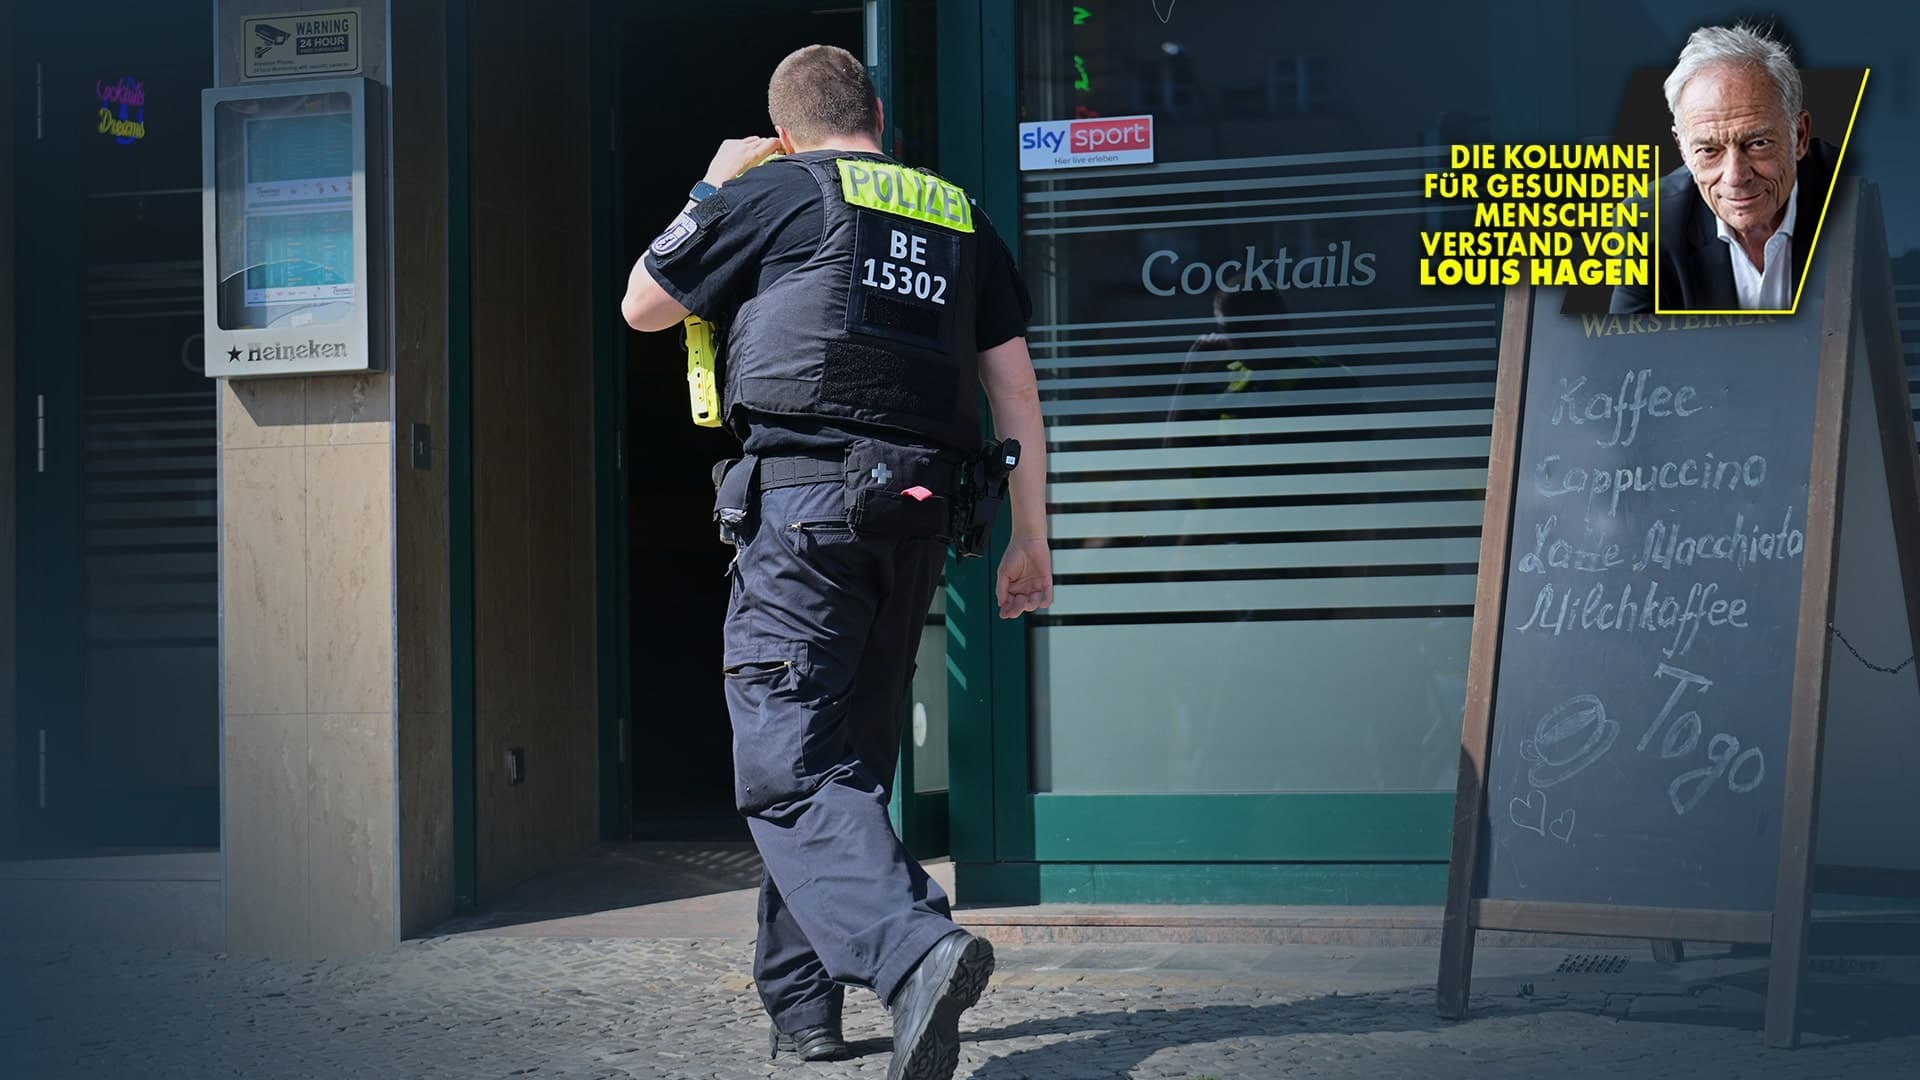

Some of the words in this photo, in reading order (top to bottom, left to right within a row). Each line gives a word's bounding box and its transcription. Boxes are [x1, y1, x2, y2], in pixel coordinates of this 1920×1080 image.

[296, 18, 349, 36] WARNING
[299, 38, 312, 48] 24
[315, 36, 344, 47] HOUR
[1022, 126, 1065, 153] sky
[1075, 123, 1145, 150] sport
[1054, 157, 1071, 165] Hier
[1072, 156, 1086, 164] live
[1088, 154, 1119, 163] erleben
[848, 164, 968, 225] POLIZEI
[890, 229, 927, 266] BE
[1141, 240, 1377, 297] Cocktails
[862, 258, 947, 305] 15302
[247, 339, 348, 362] Heineken
[1551, 368, 1702, 448] Kaffee
[1535, 452, 1767, 521] Cappuccino
[1632, 505, 1804, 574] Macchiato
[1516, 581, 1750, 659] Milchkaffee
[1636, 663, 1713, 759] To
[1669, 732, 1766, 815] go
